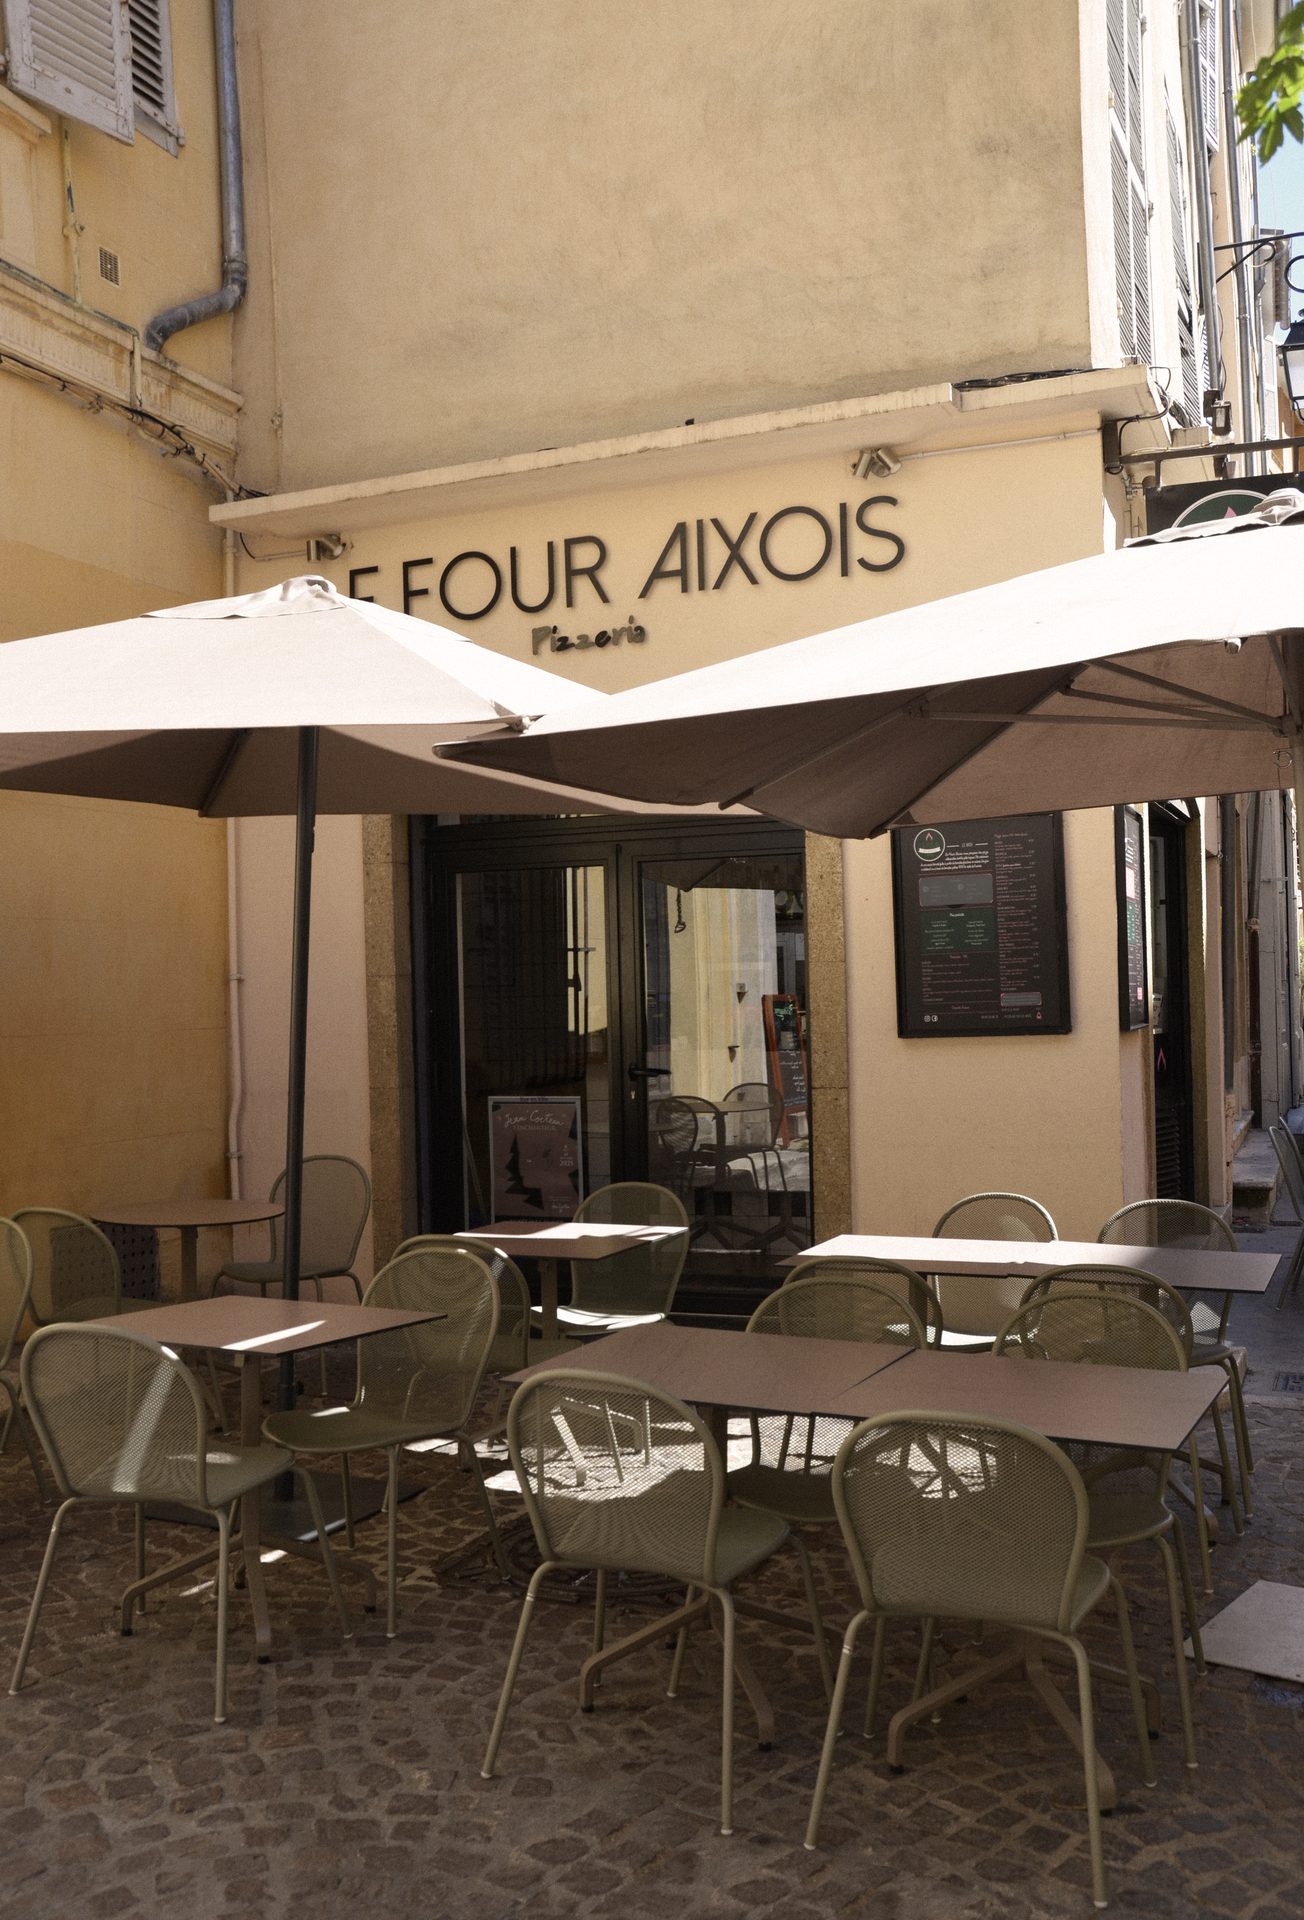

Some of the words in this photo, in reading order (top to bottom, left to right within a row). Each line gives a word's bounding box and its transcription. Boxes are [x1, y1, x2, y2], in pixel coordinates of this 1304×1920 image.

[402, 535, 611, 621] FOUR
[637, 495, 906, 600] AIXOIS
[531, 614, 647, 656] Pizzeria
